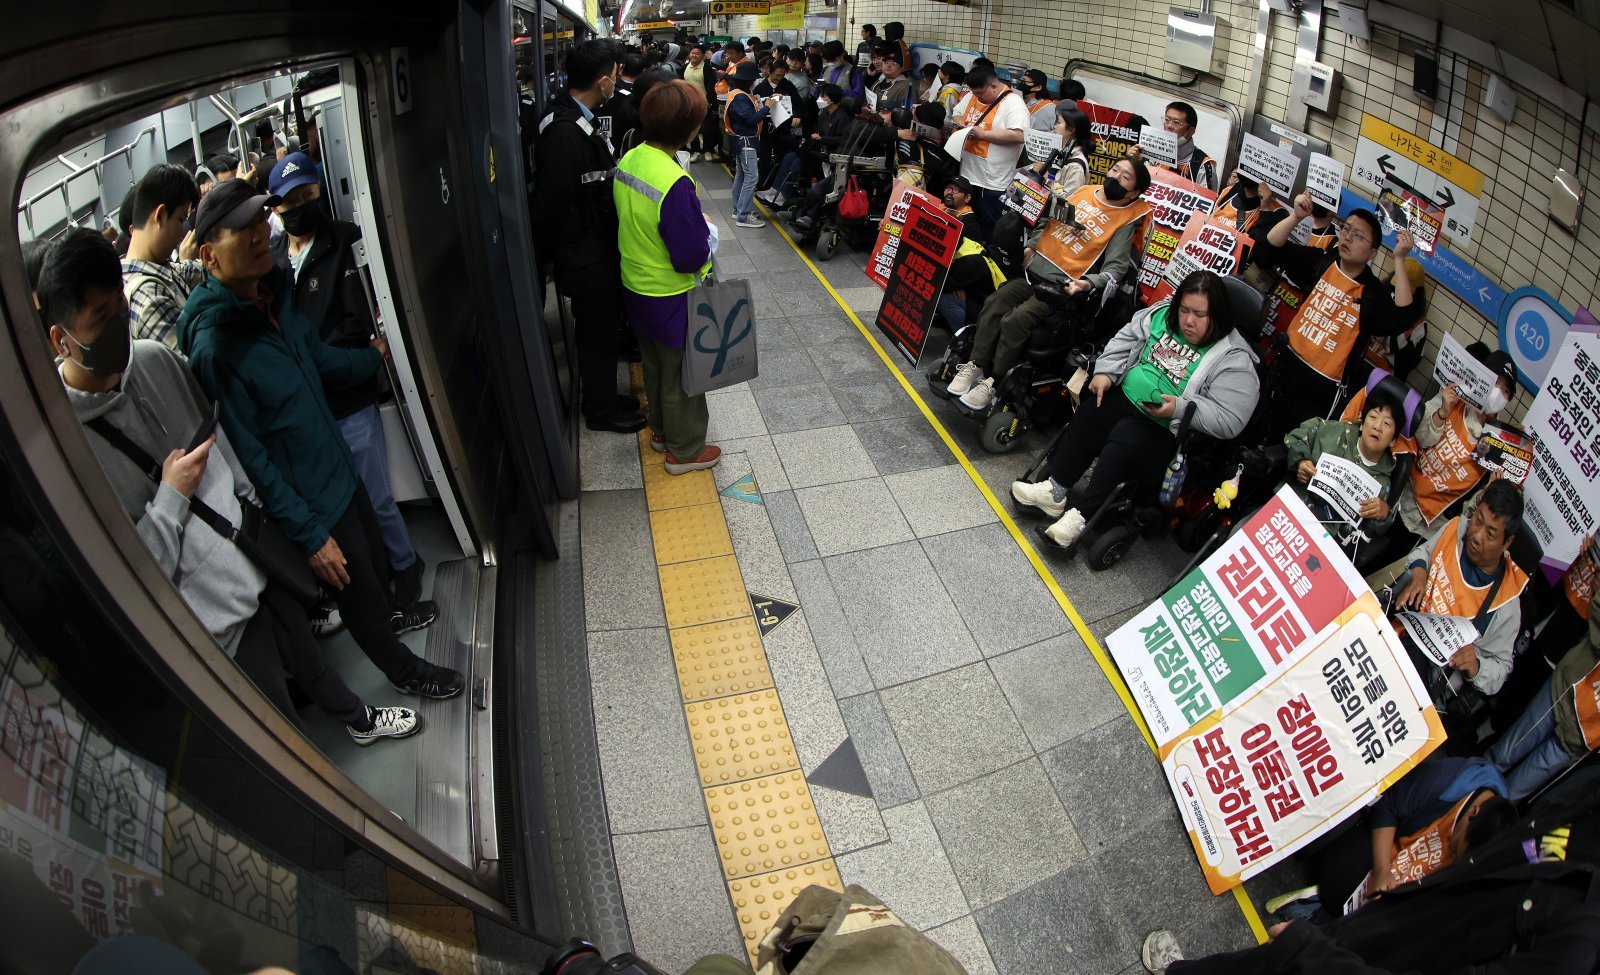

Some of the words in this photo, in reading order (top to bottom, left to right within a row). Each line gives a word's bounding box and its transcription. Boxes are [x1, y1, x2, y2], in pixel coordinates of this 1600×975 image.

[1090, 121, 1109, 137] 22대
[1110, 123, 1139, 141] 국회는
[1390, 131, 1423, 158] 나가는
[1426, 149, 1438, 167] 곳
[1440, 155, 1452, 167] Exit
[1199, 227, 1236, 253] 해고는
[1447, 217, 1469, 237] 출구
[897, 263, 936, 301] 독소조항
[904, 250, 937, 281] 시행령
[1434, 250, 1472, 281] Dongdaemun
[1315, 278, 1352, 307] 장애인도
[1303, 306, 1340, 335] 이동하는
[1519, 322, 1546, 352] 420
[1547, 376, 1594, 440] 연속적인
[1548, 408, 1573, 446] 참여
[1269, 508, 1310, 558] 장애인
[1254, 523, 1313, 599] 평생교육을
[755, 601, 780, 627] 6-1
[1190, 579, 1233, 637] 장애인
[1216, 545, 1308, 667] 권리로
[1171, 595, 1233, 684] 평생교육법
[1321, 656, 1366, 725] 이동의
[1351, 716, 1386, 766] 자유
[1343, 636, 1390, 706] 모두를
[1376, 698, 1410, 748] 위한
[1276, 692, 1345, 798] 장애인
[1240, 722, 1307, 824] 이동권
[1192, 726, 1275, 868] 보장하라!
